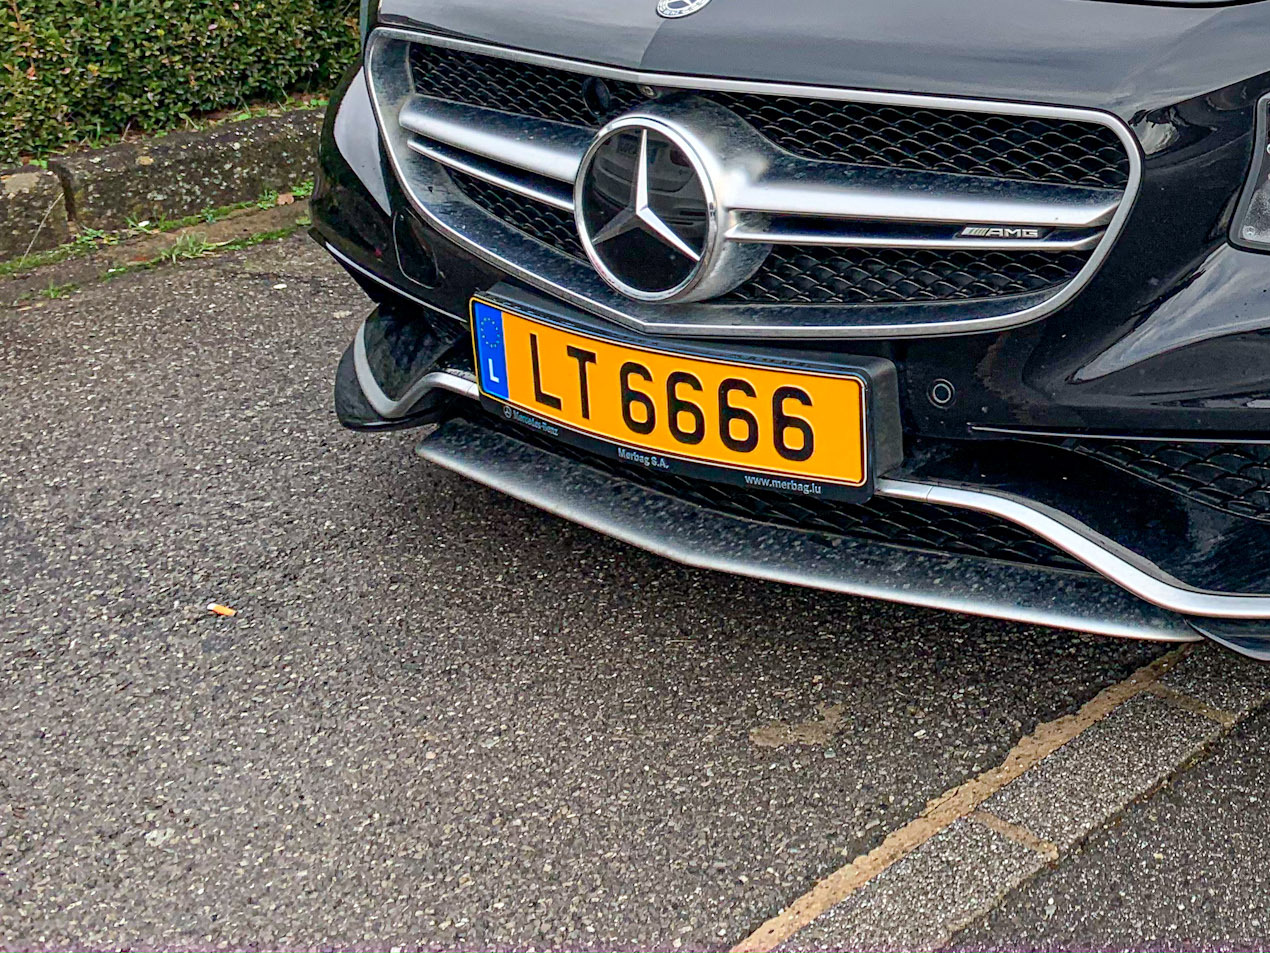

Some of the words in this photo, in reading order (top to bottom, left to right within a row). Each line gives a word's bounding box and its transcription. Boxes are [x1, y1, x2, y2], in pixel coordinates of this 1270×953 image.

[985, 228, 1039, 238] AMG
[488, 359, 500, 383] L
[529, 333, 597, 420] LT
[620, 361, 814, 462] 6666
[512, 409, 559, 436] Mercedes-Benz
[617, 448, 650, 469] Merbag
[651, 456, 669, 469] S.A.
[744, 474, 822, 494] www.merbag.lu
